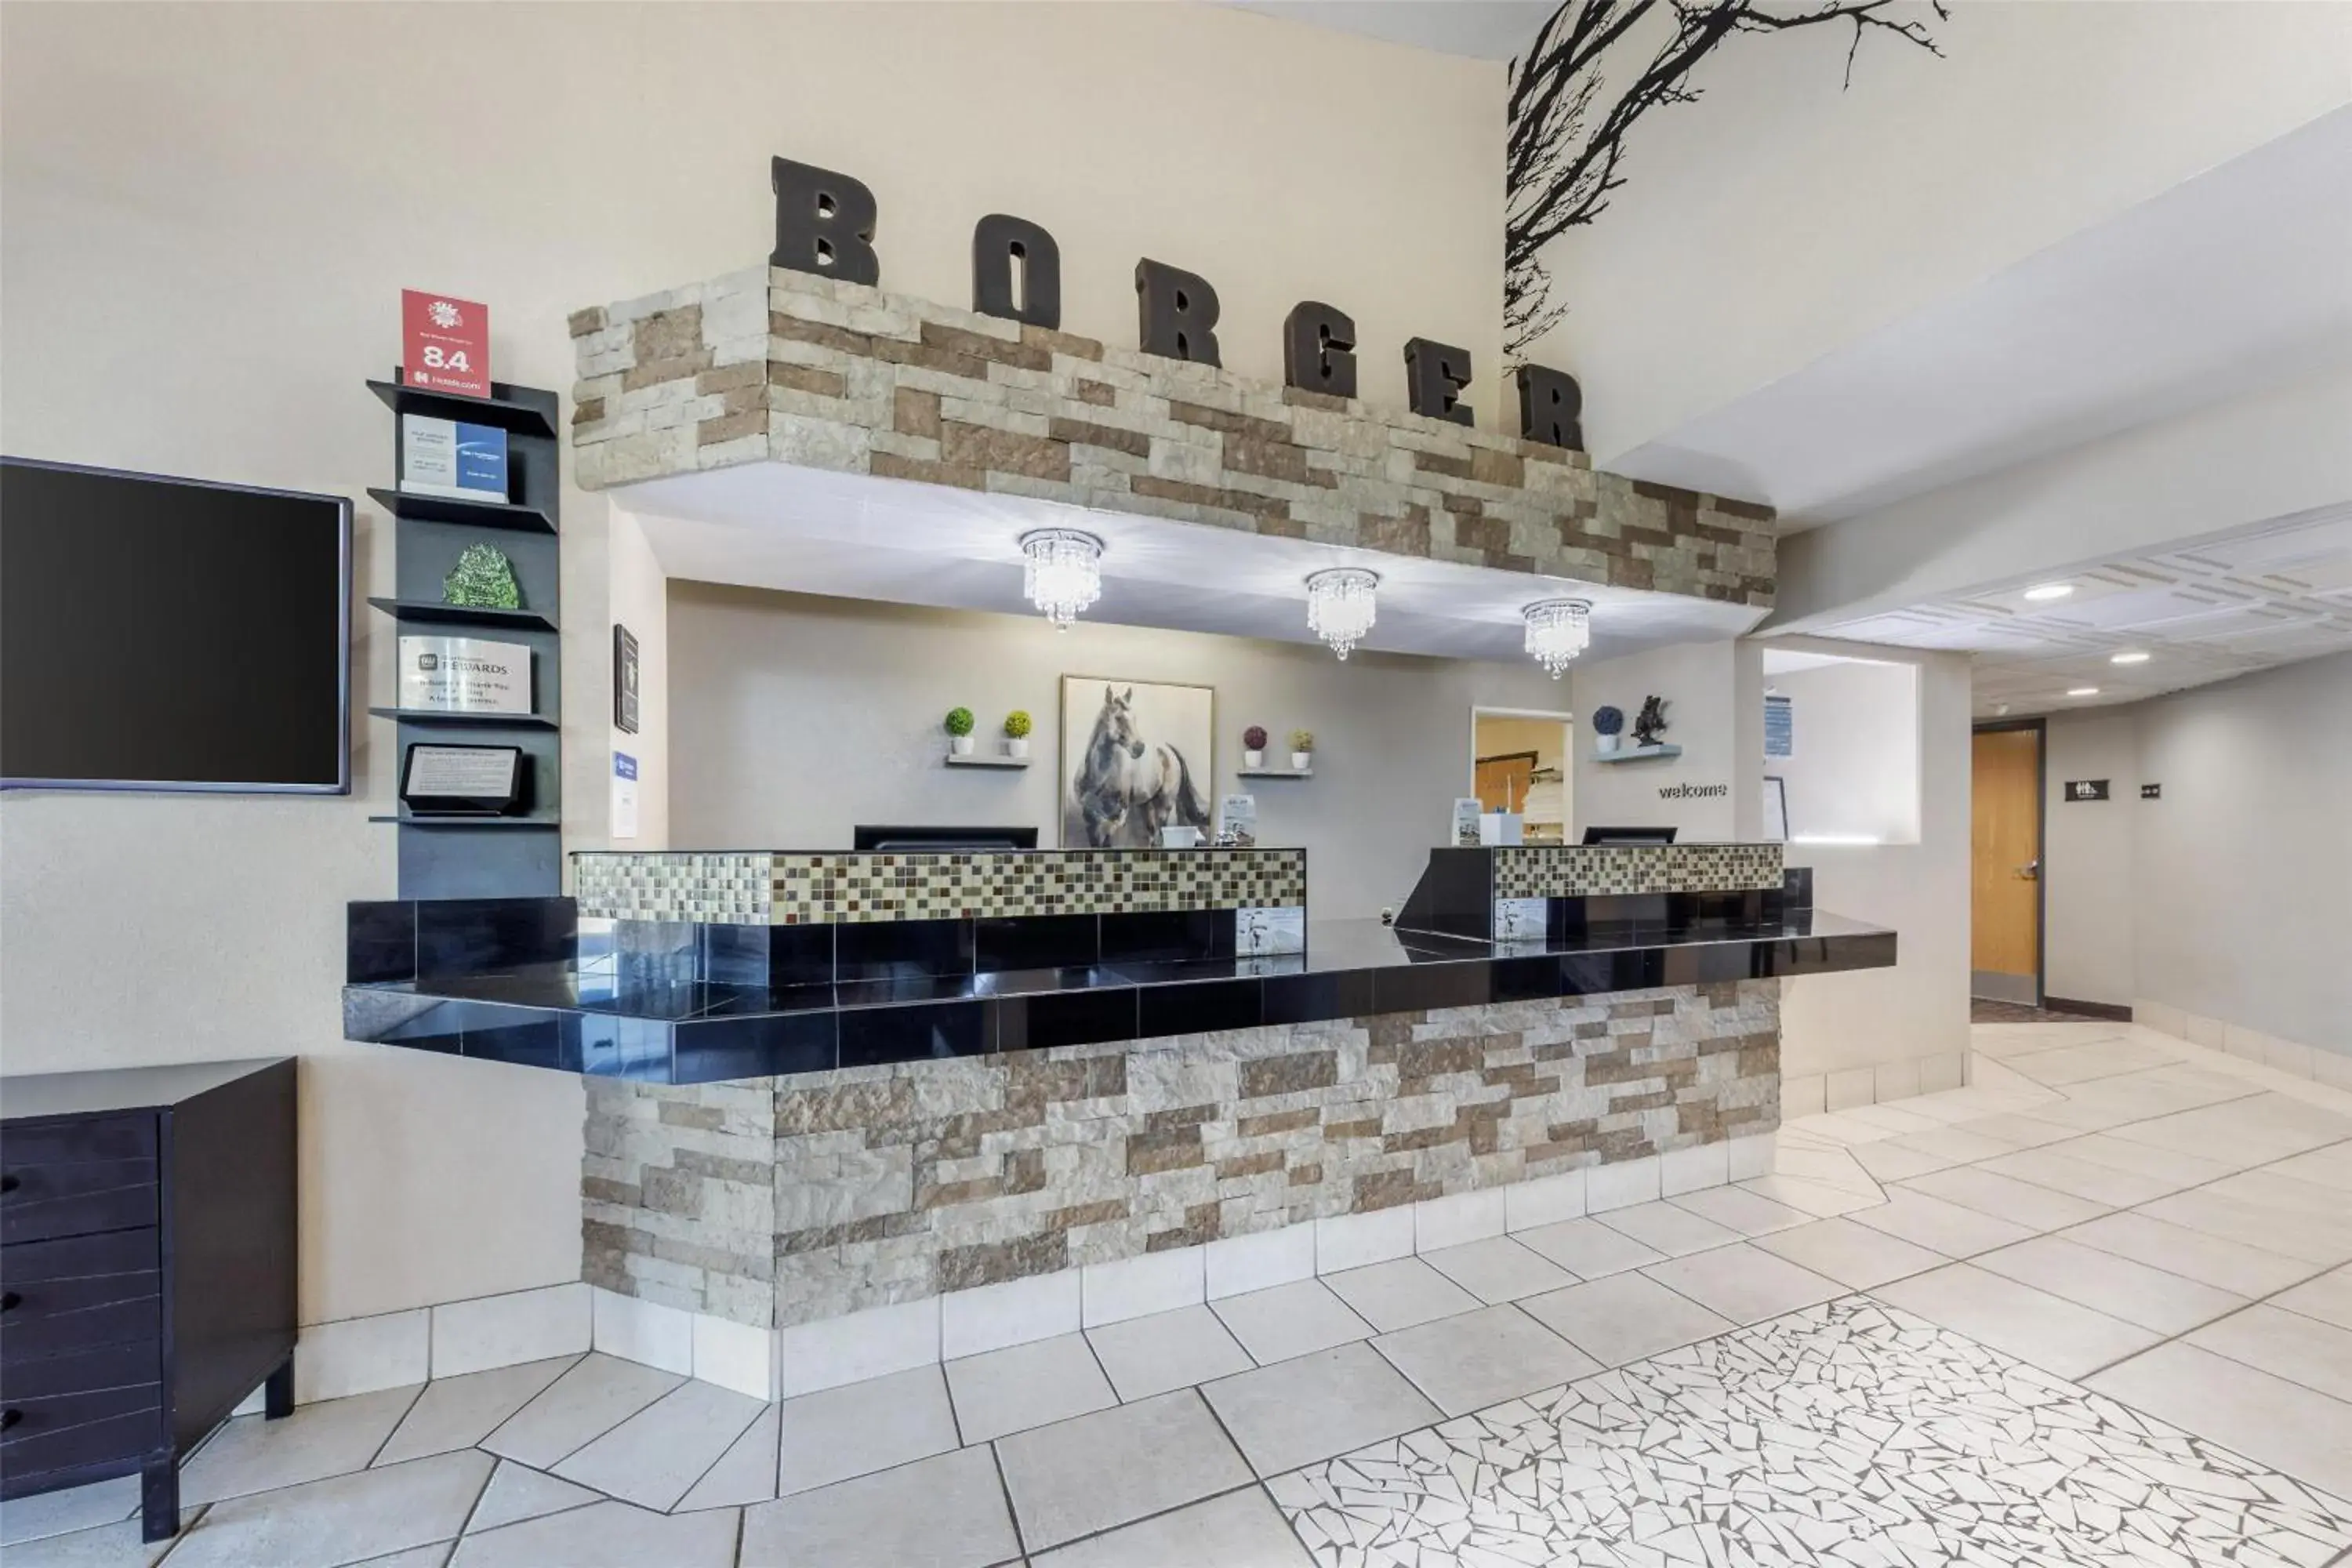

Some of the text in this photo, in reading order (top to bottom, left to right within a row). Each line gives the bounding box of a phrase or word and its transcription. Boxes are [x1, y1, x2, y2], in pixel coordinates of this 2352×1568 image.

[771, 154, 1584, 451] BORGER
[424, 346, 470, 372] 8.4
[1659, 782, 1727, 799] welcome
